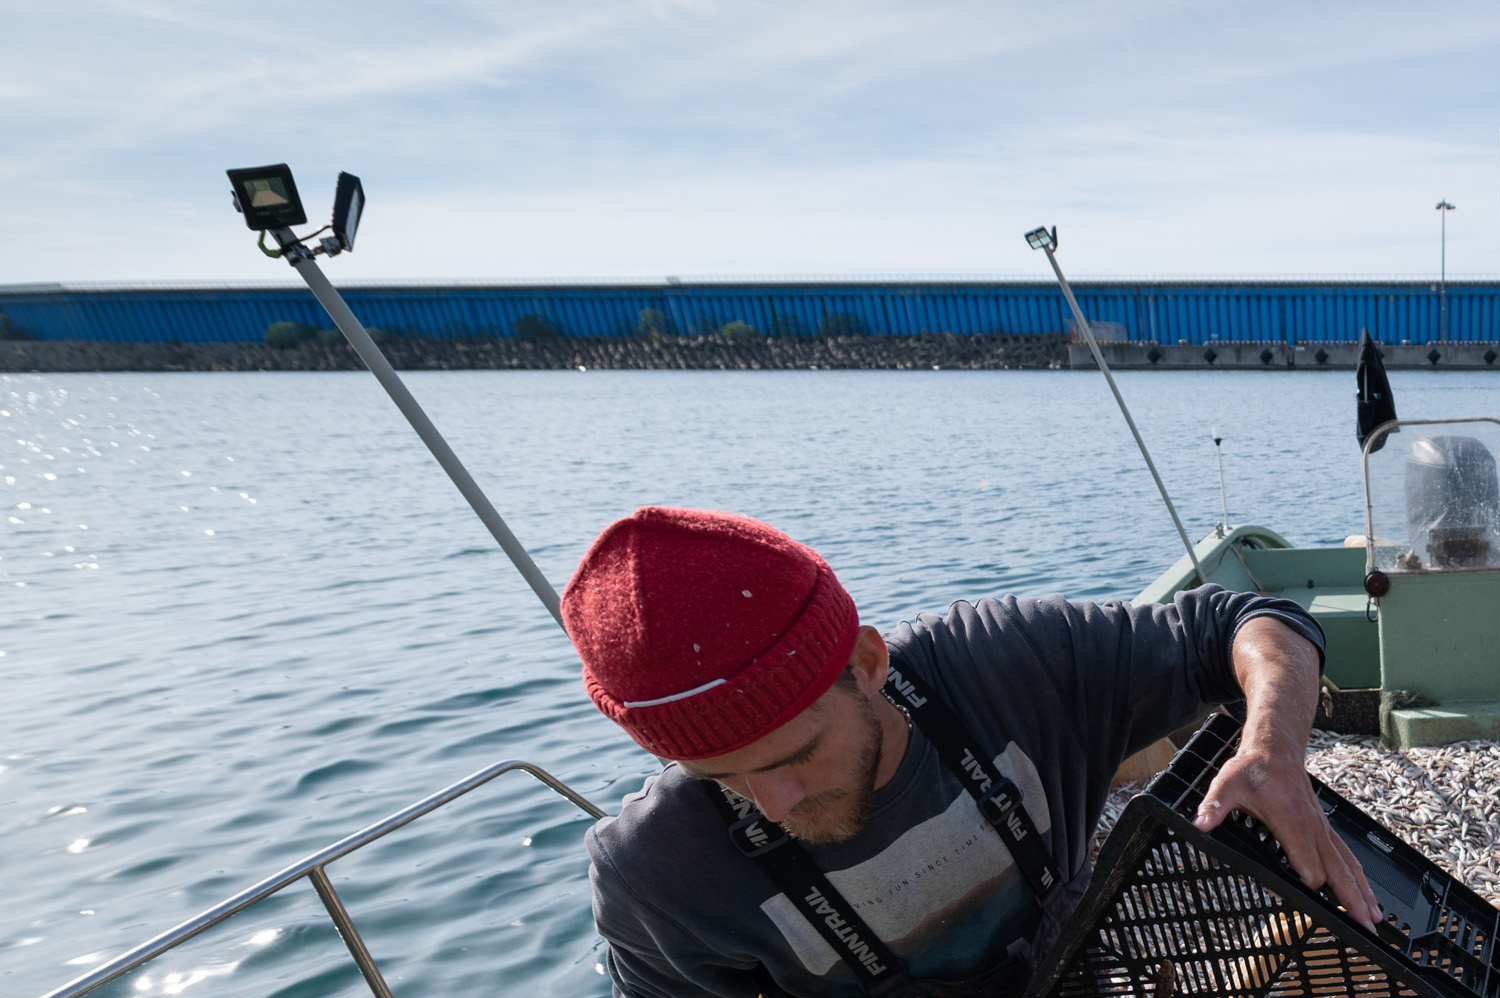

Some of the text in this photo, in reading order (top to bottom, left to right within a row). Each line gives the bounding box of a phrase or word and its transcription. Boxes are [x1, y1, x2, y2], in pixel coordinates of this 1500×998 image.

[888, 880, 910, 896] FUN
[914, 856, 950, 878] SINCE
[955, 834, 979, 855] TIME
[804, 886, 887, 977] FINNTRAIL
